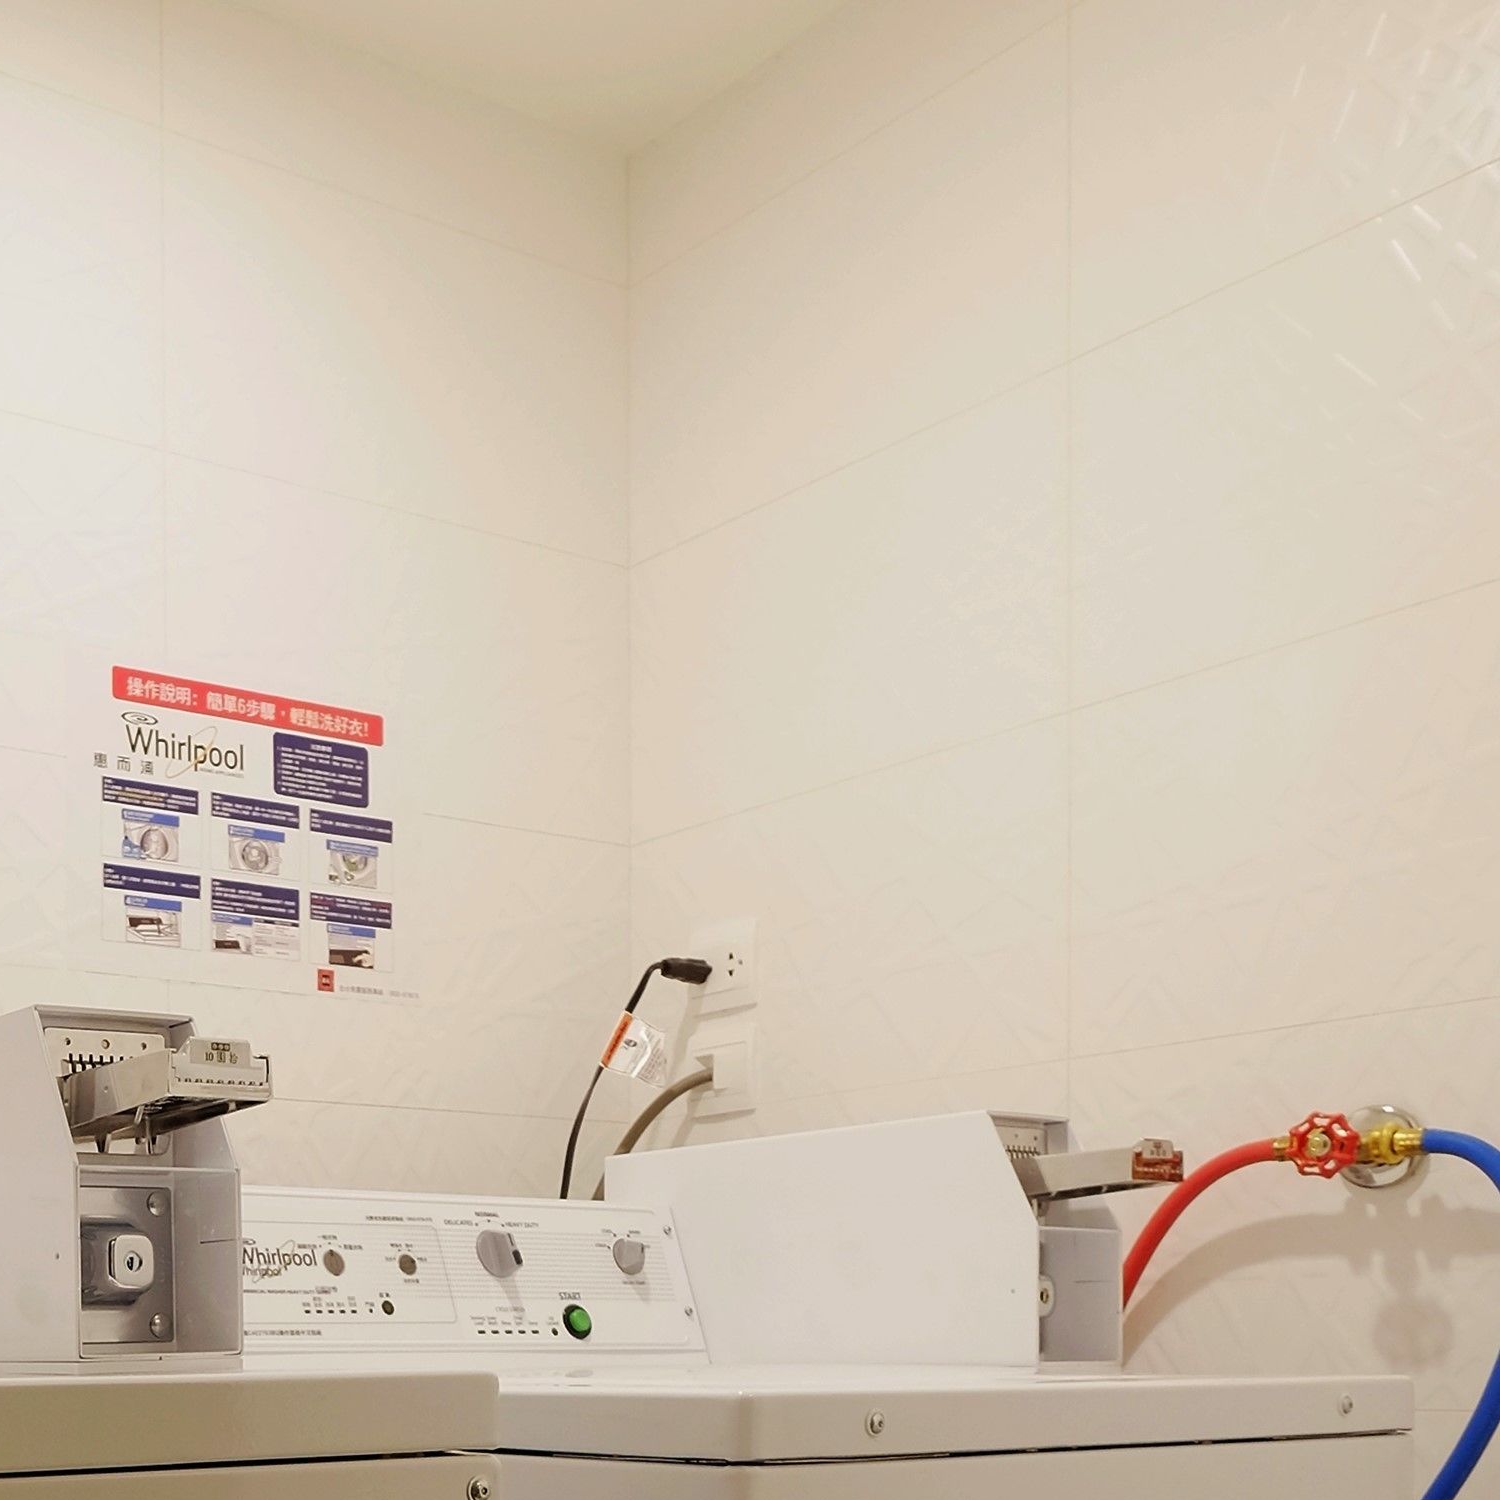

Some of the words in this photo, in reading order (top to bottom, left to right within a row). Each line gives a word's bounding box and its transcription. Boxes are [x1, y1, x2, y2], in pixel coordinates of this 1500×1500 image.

[126, 724, 244, 771] Whirlpool
[205, 1052, 214, 1061] 10
[558, 1292, 581, 1301] START
